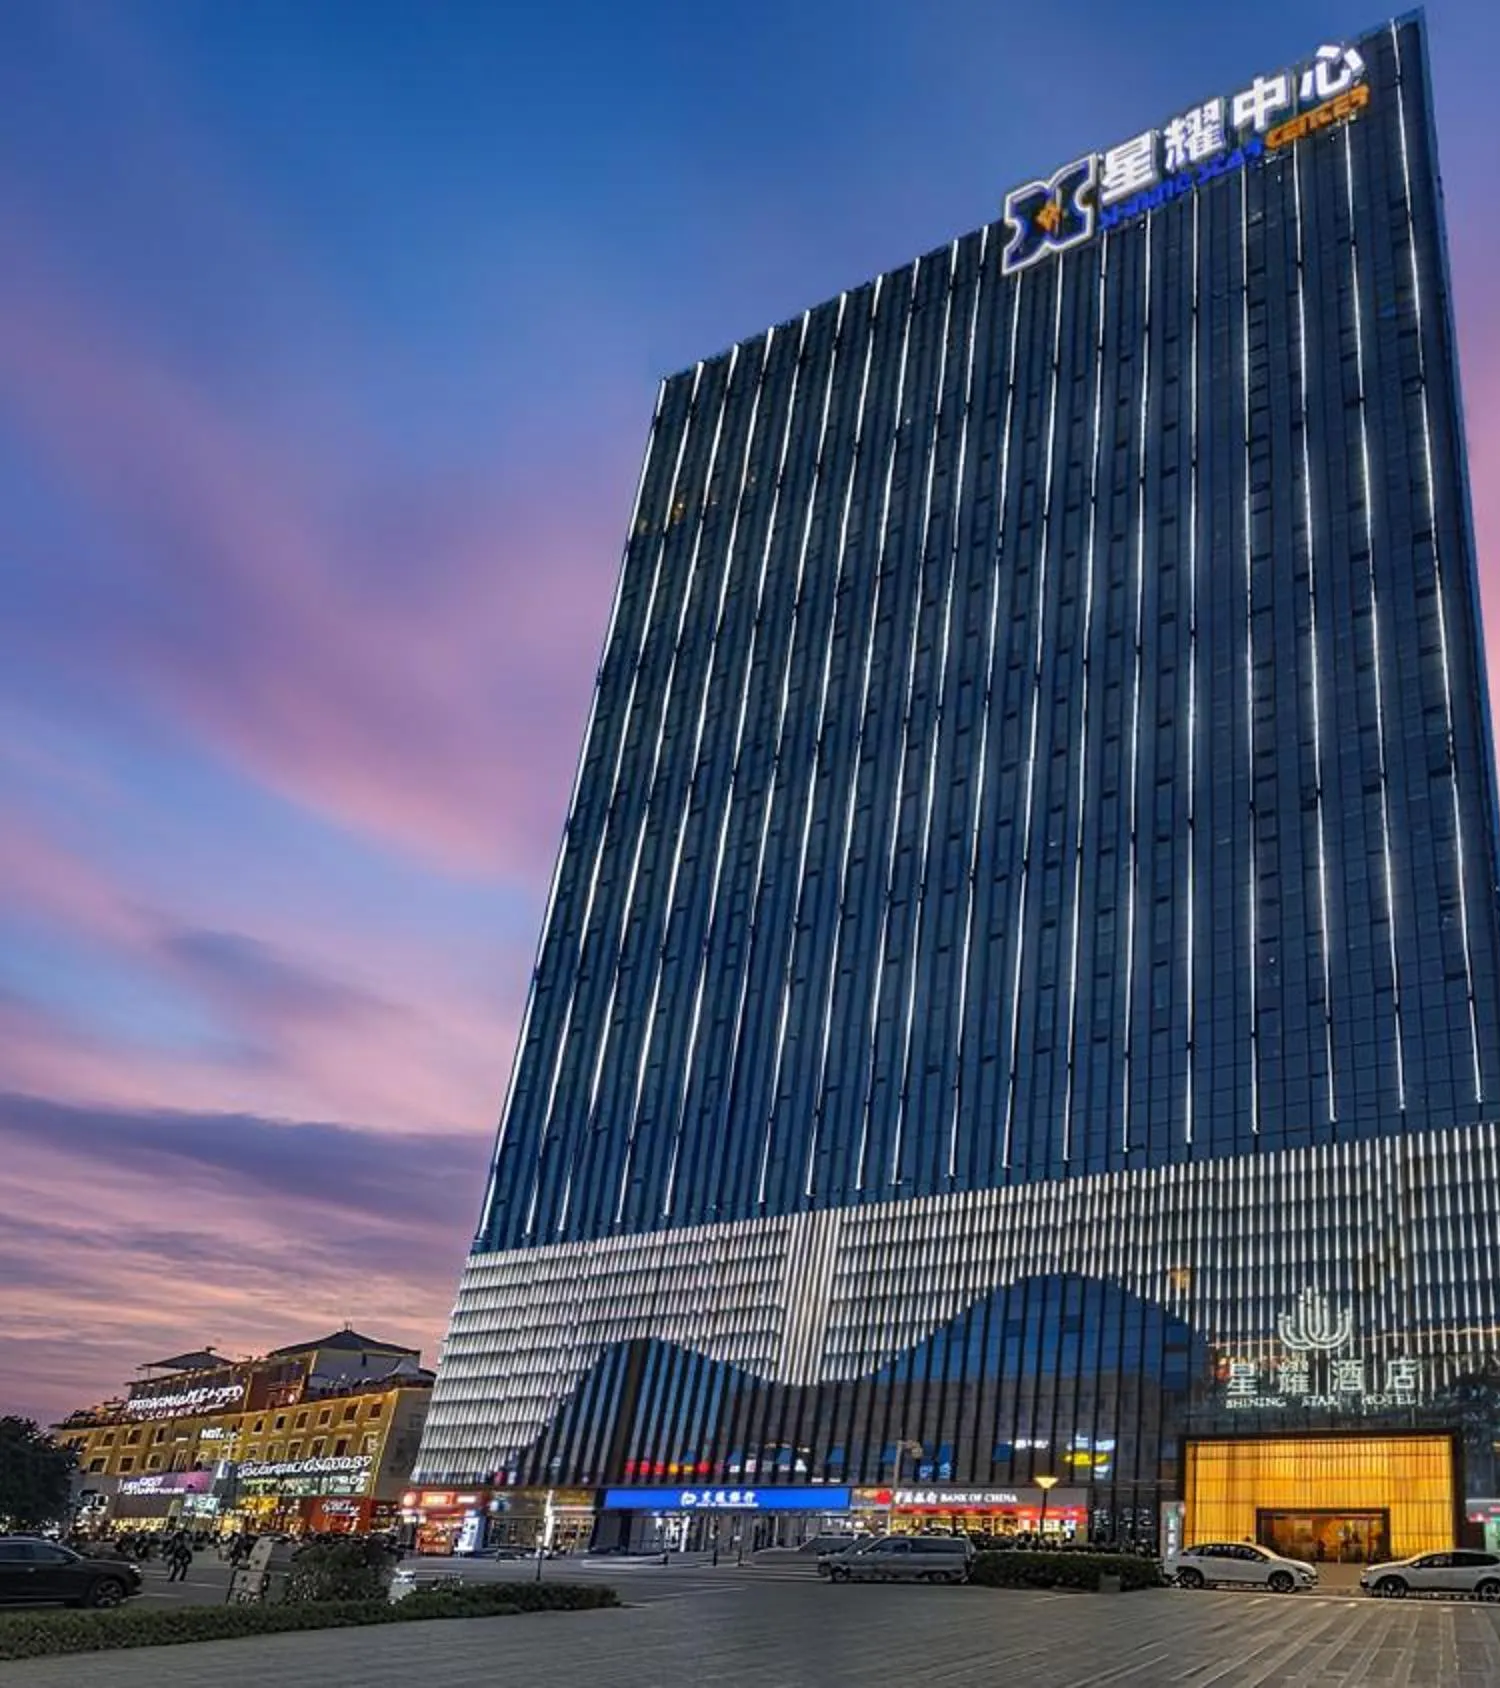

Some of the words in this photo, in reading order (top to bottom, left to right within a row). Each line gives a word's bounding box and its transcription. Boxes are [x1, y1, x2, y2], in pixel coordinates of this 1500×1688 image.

[1101, 44, 1364, 203] 星耀中心
[1226, 1353, 1422, 1396] 星耀酒店
[1225, 1396, 1287, 1409] SHINING
[1361, 1393, 1417, 1406] HOTEL
